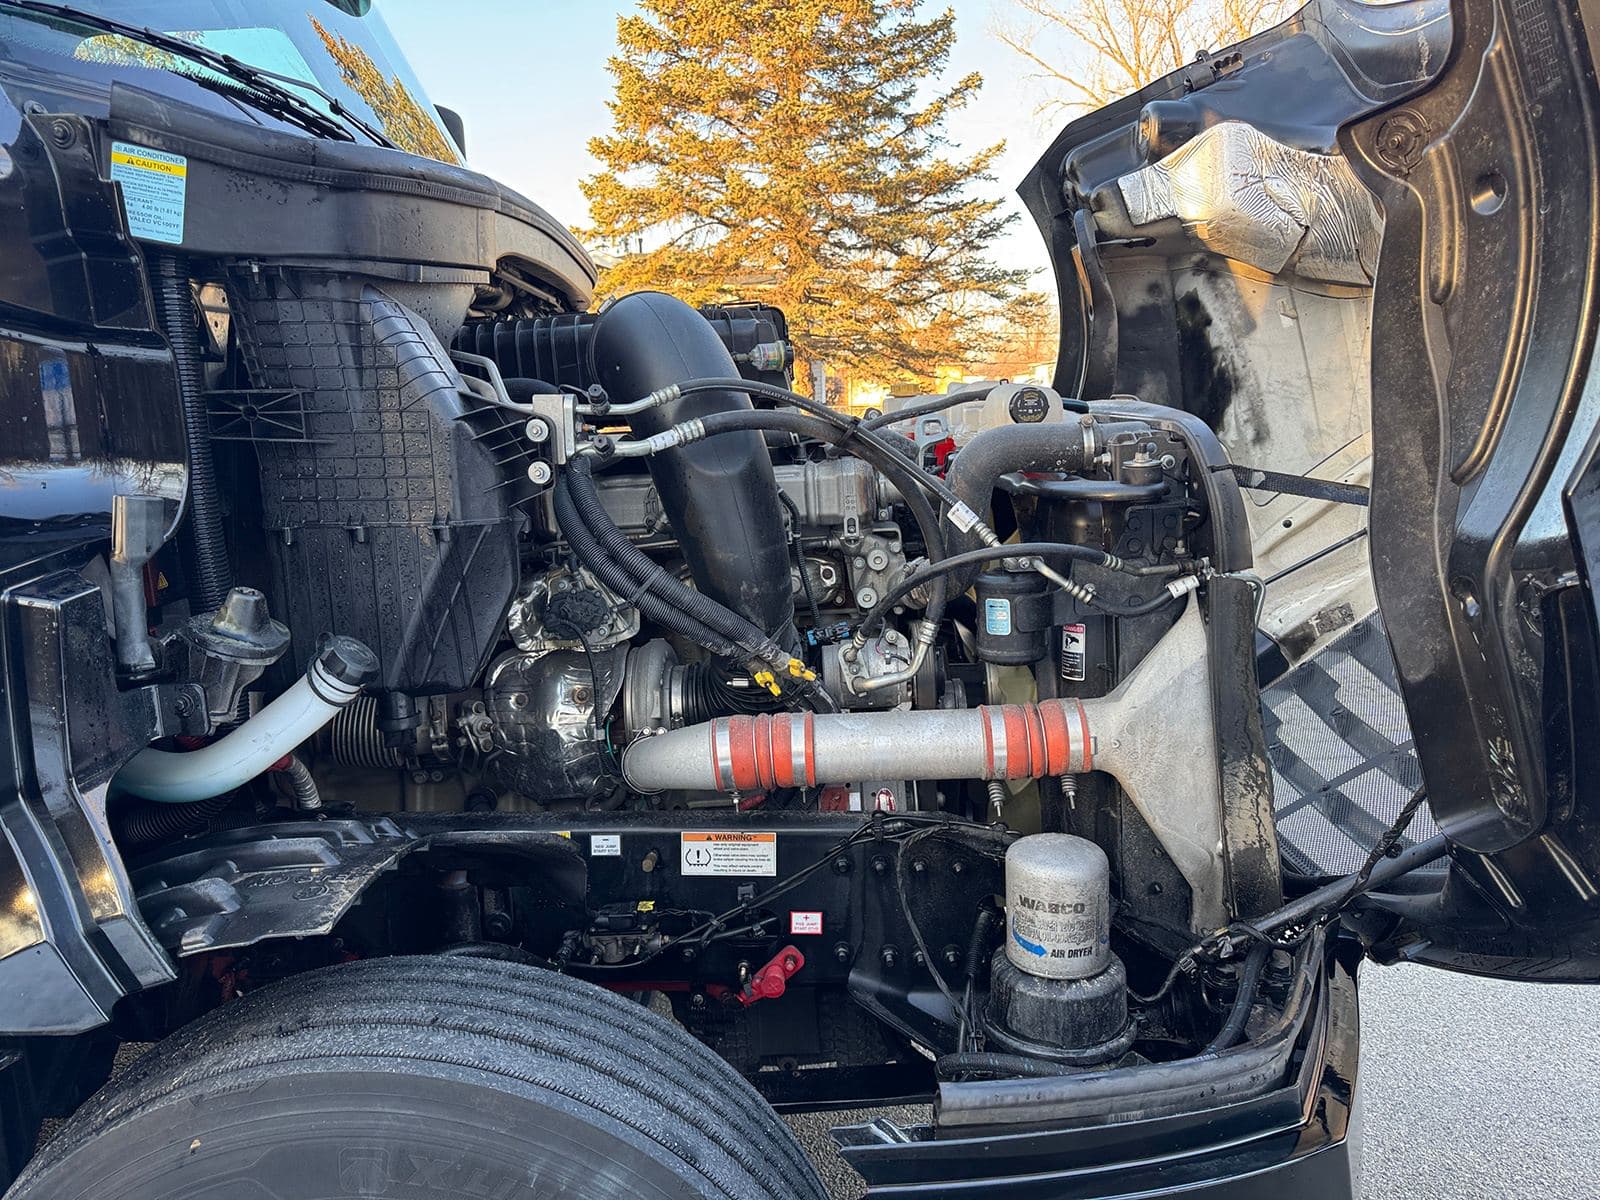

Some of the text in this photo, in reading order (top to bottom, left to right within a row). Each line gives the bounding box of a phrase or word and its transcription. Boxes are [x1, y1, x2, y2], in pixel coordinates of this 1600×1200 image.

[123, 146, 184, 164] AIR CONDITIONER
[135, 158, 171, 172] CAUTION
[129, 215, 151, 223] VALEO
[1019, 895, 1086, 914] WABCO
[1050, 946, 1092, 958] AIR DRYER
